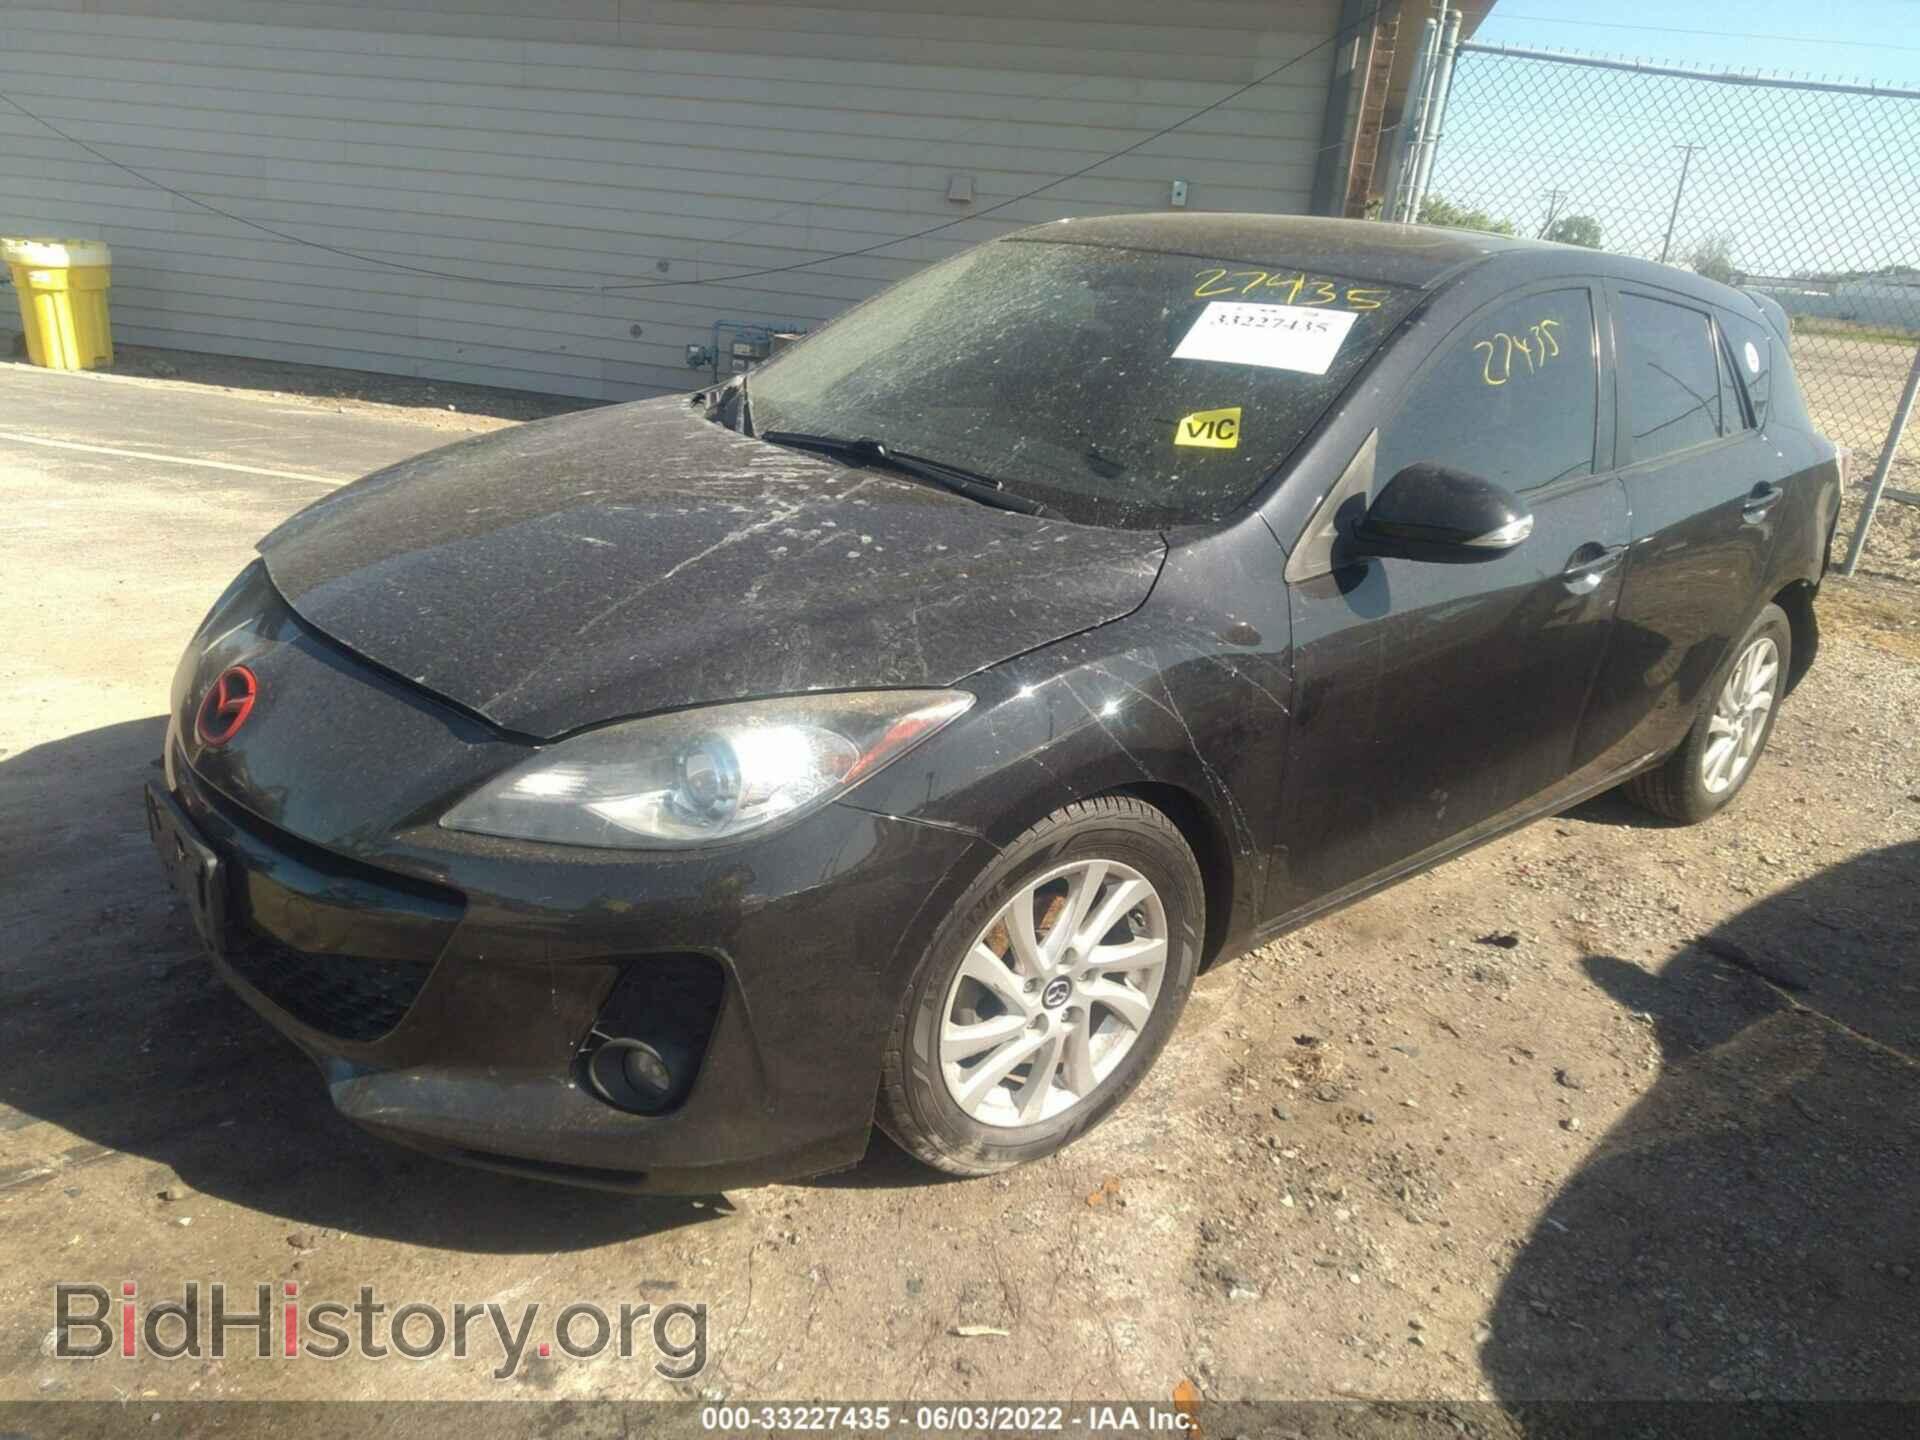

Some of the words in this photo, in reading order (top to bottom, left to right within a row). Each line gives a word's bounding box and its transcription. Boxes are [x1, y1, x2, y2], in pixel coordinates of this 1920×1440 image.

[1195, 269, 1390, 310] 27435
[1473, 319, 1560, 385] 27435
[1186, 418, 1236, 441] VIC
